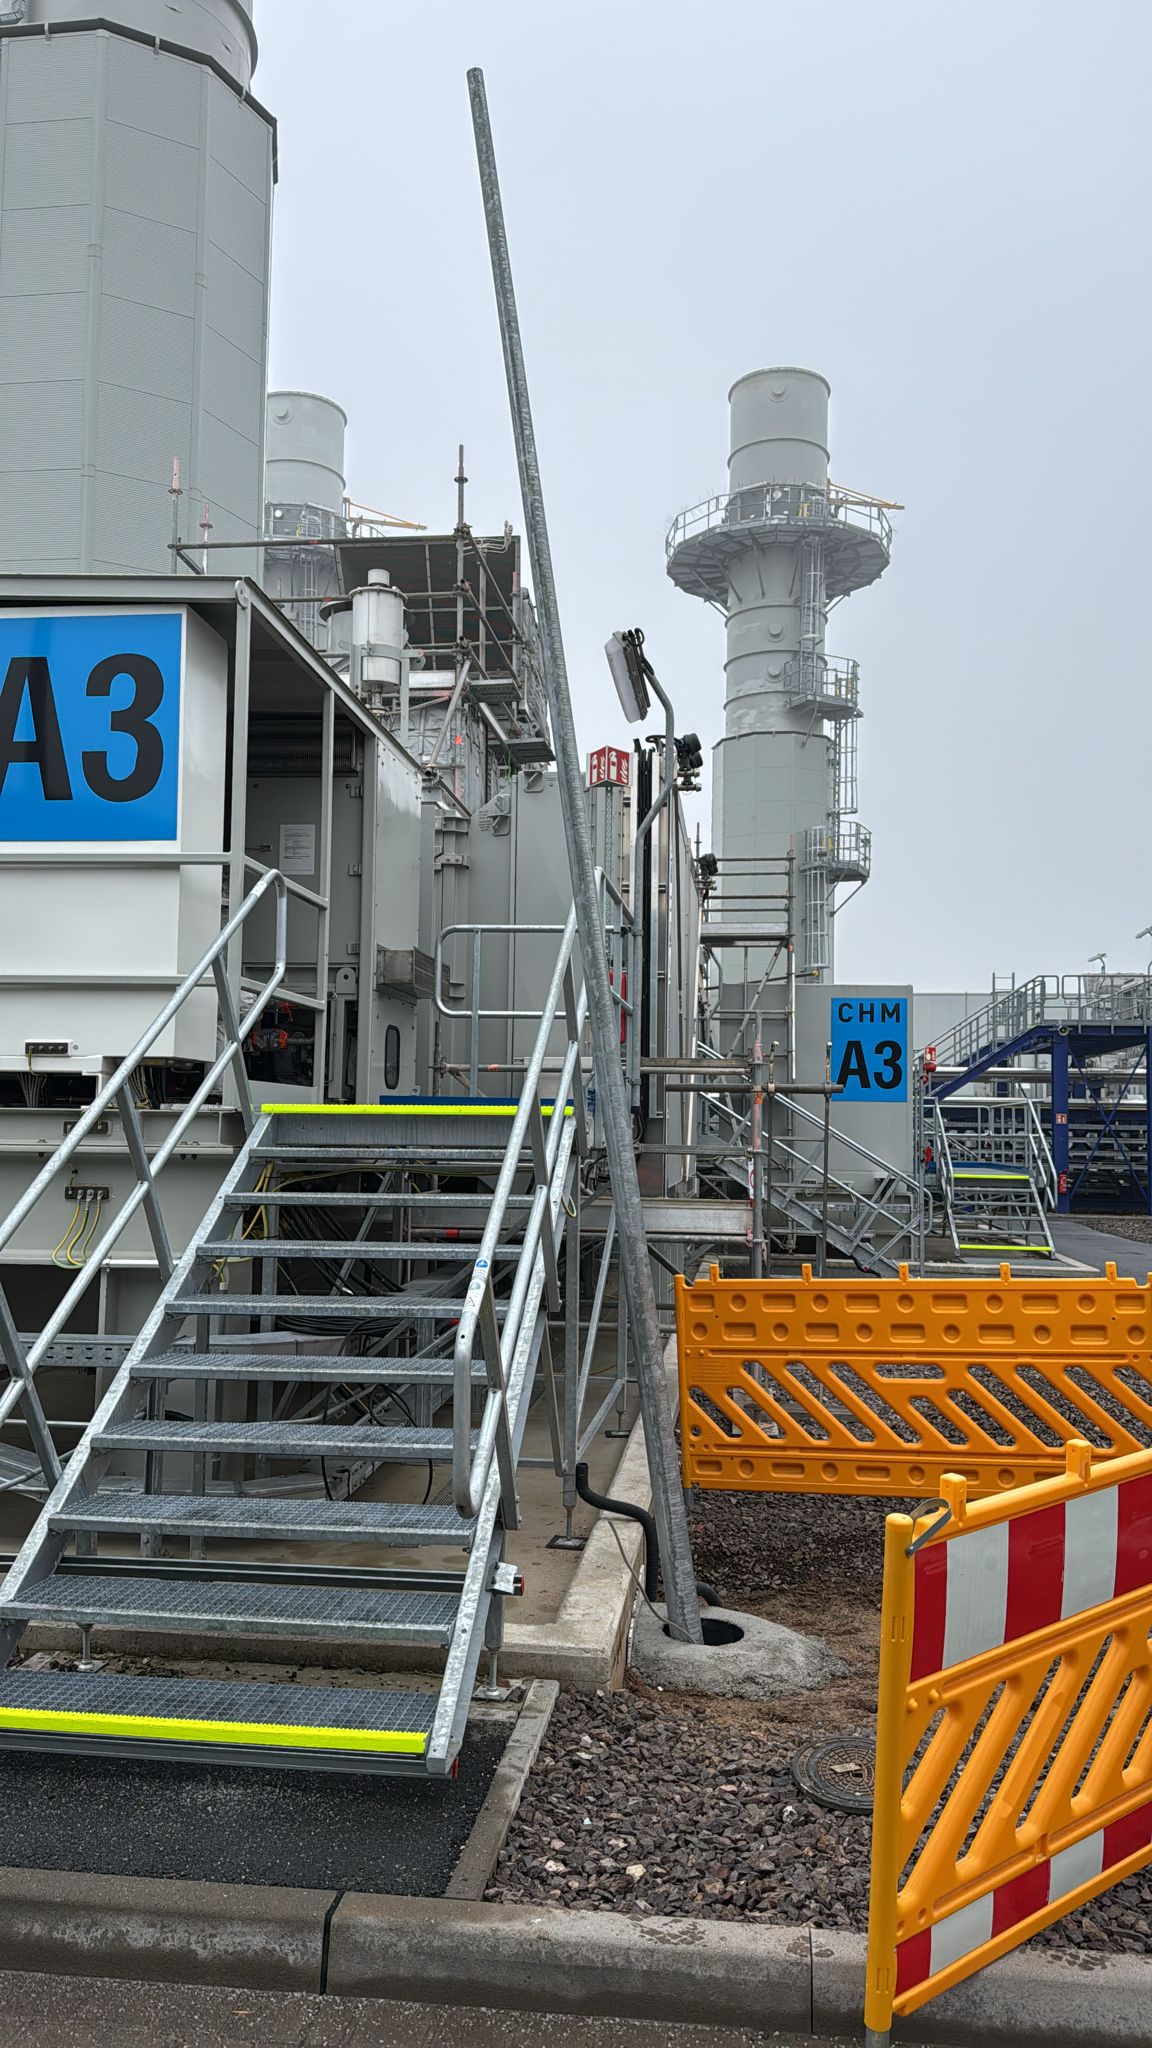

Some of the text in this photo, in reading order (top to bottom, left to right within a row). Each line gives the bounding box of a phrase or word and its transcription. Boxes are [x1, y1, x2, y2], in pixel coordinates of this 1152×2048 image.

[0, 653, 164, 803] A3
[838, 1003, 900, 1023] CHM
[837, 1040, 902, 1089] A3
